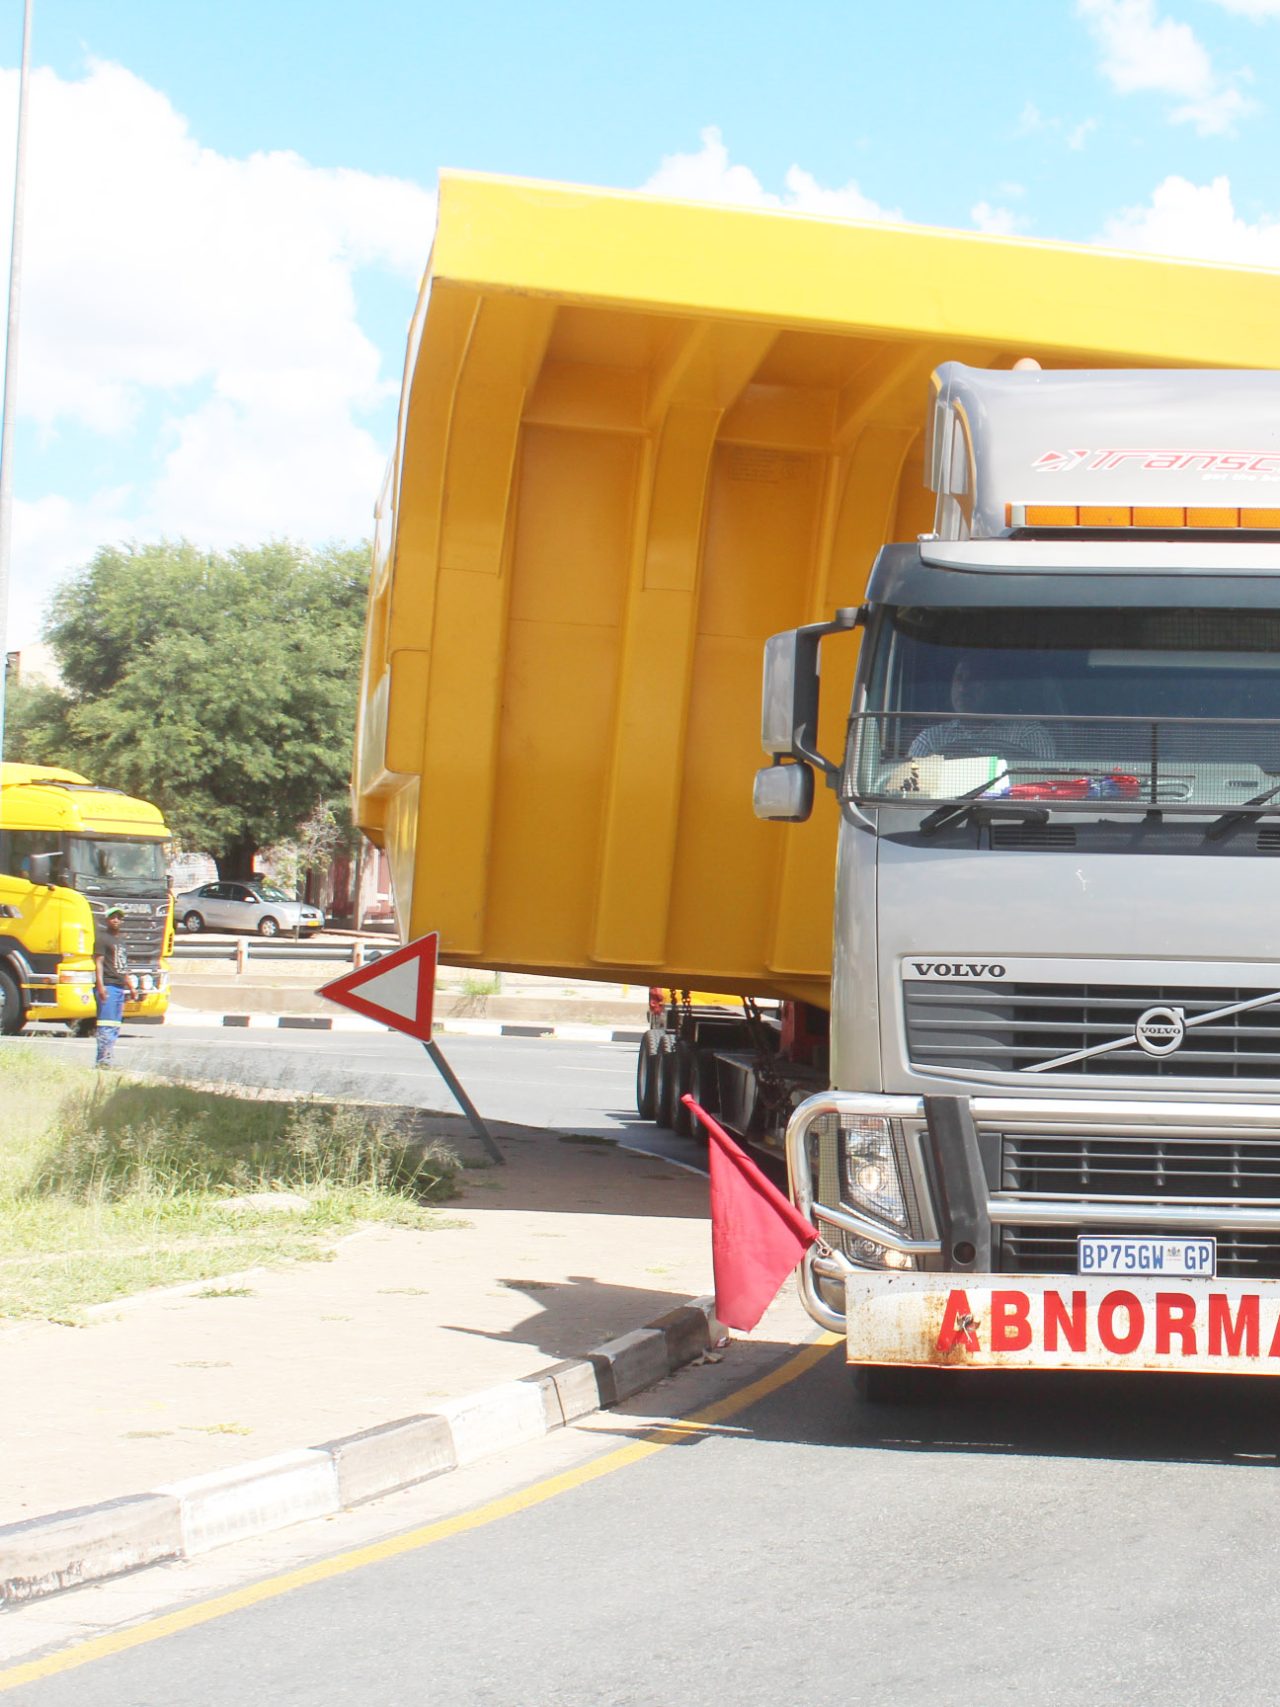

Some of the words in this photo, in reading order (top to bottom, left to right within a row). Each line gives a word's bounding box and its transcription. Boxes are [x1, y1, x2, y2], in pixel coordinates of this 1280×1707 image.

[911, 963, 1006, 978] VOLVO
[1140, 1027, 1181, 1035] VOLVO
[1082, 1244, 1164, 1270] BP75GW
[1184, 1245, 1210, 1270] GP
